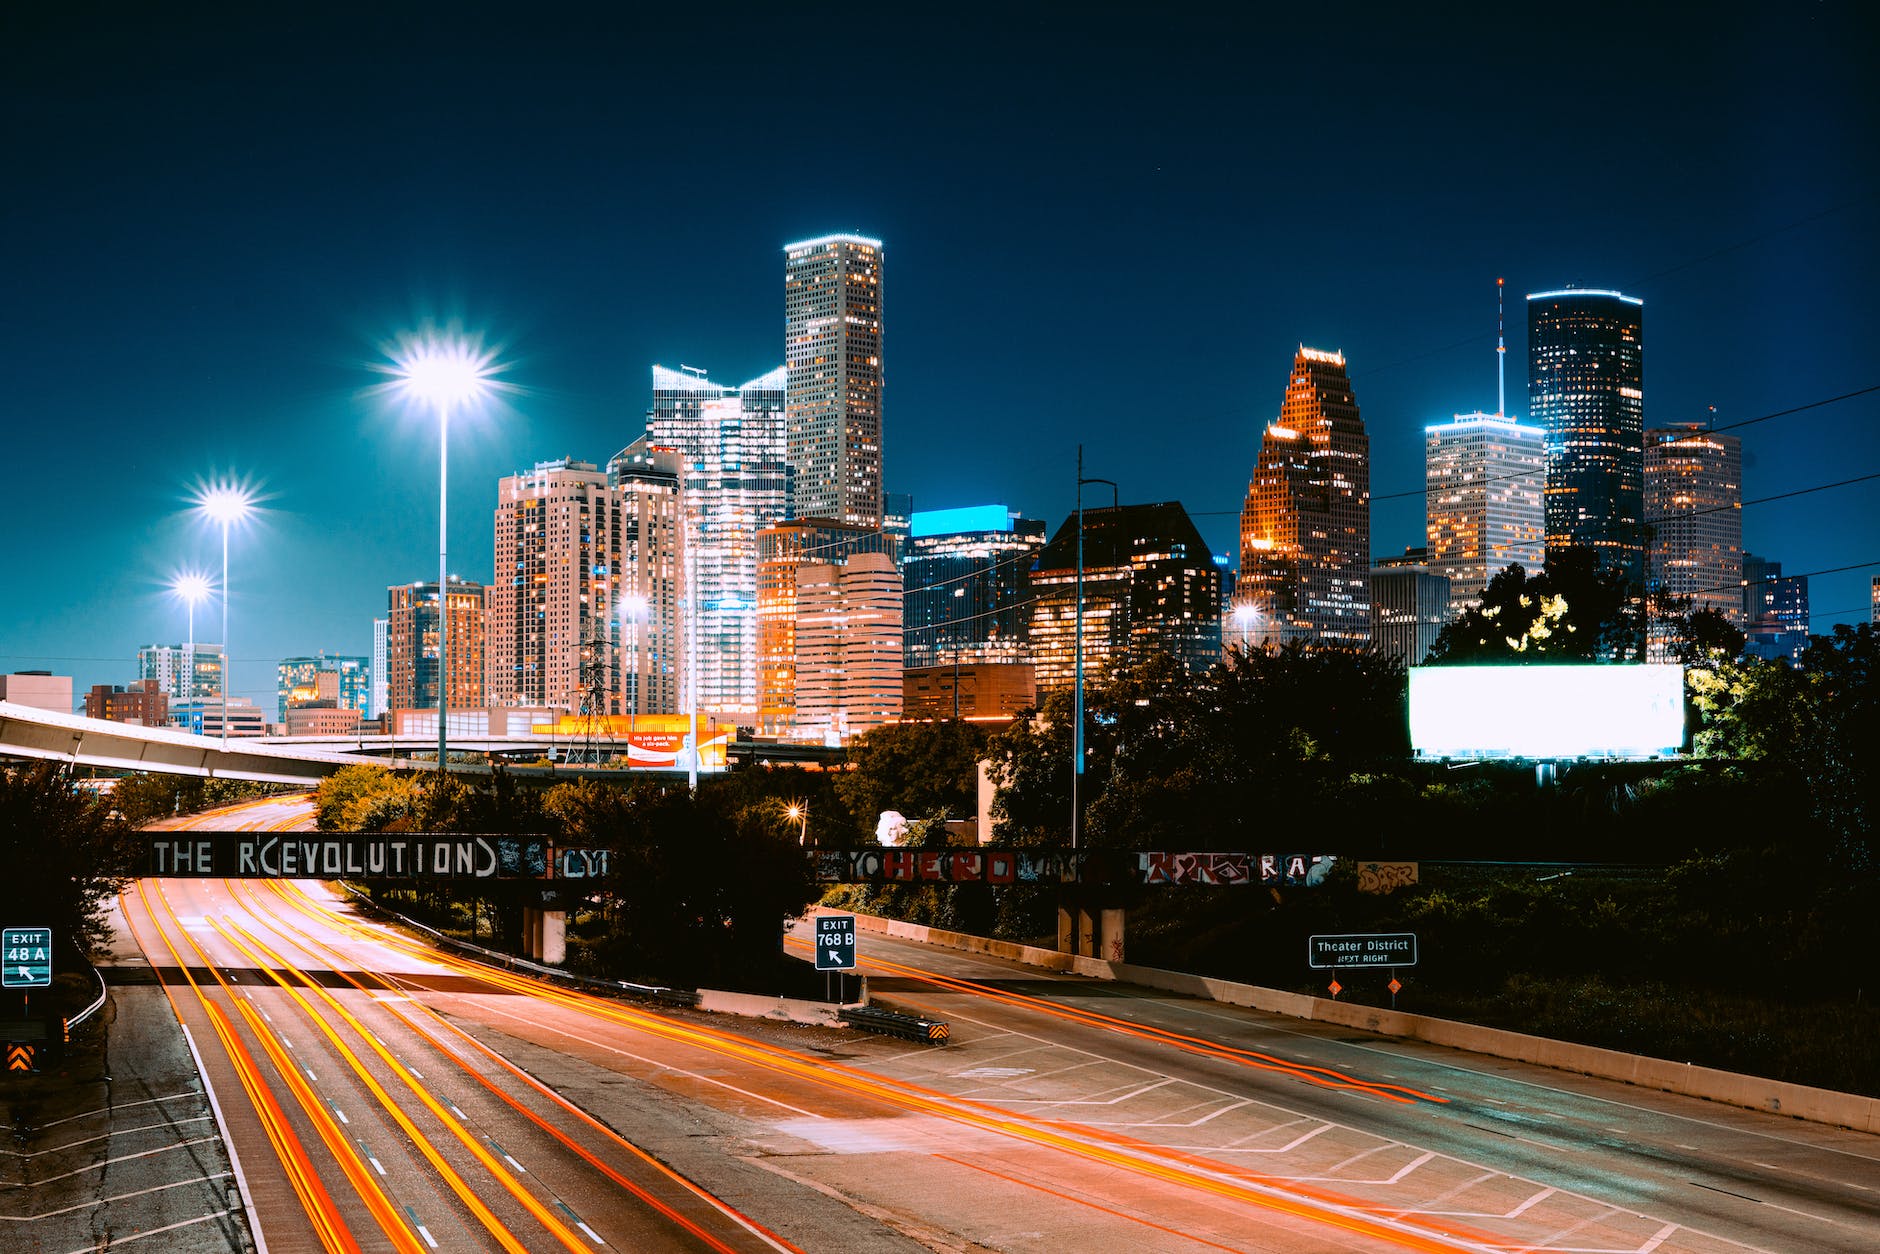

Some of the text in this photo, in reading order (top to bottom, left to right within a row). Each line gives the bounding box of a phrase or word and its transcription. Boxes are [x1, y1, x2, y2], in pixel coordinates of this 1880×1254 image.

[154, 841, 212, 873] THE
[823, 921, 848, 930] EXIT
[12, 934, 42, 944] EXIT
[817, 932, 854, 946] 768 B
[1317, 940, 1409, 952] Theater District
[8, 947, 46, 961] 48 A
[1338, 954, 1389, 963] NEXT RIGHT
